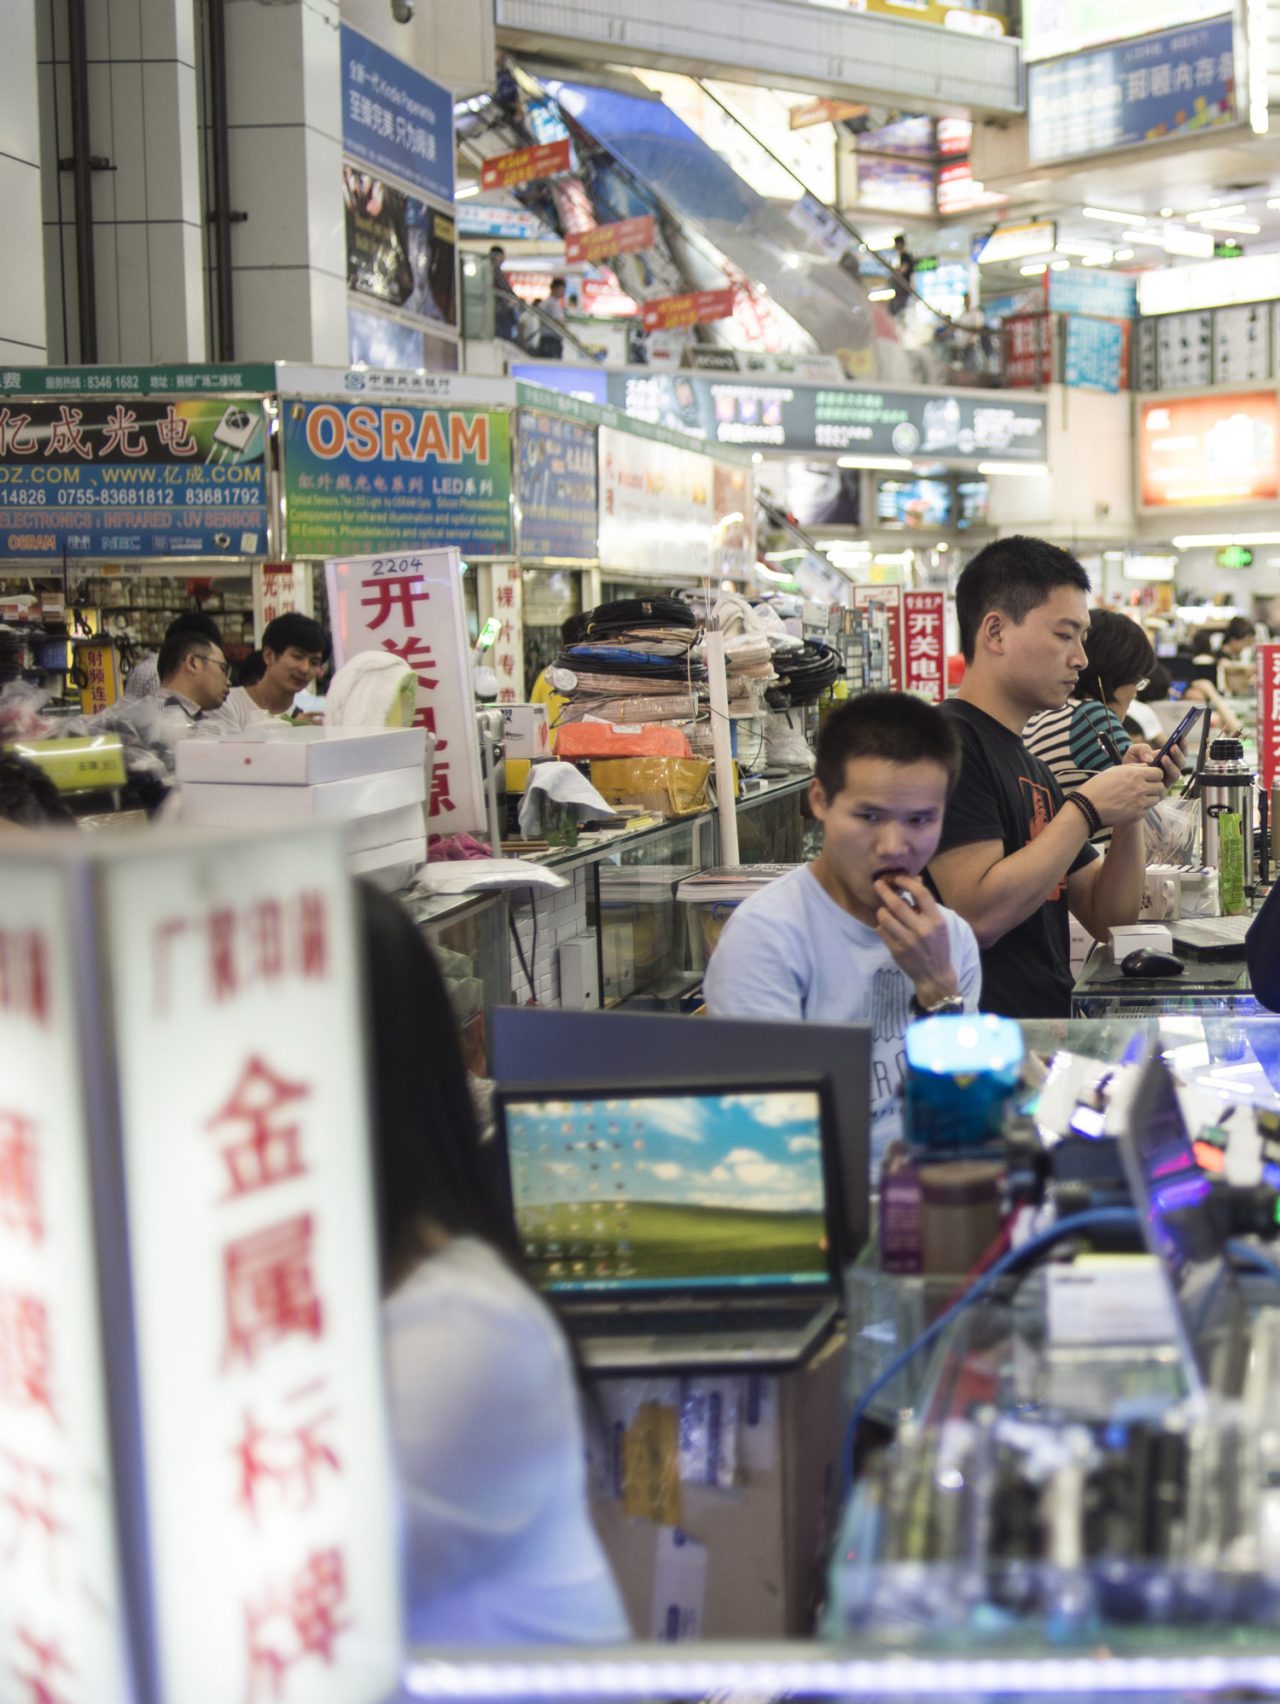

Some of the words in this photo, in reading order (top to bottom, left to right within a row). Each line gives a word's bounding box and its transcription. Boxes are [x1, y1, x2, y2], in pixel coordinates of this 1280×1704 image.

[0, 372, 21, 389] 费
[0, 404, 198, 460] 亿成光电
[306, 404, 490, 465] OSRAM
[58, 488, 174, 505] 0755-83681812
[185, 488, 260, 505] 83681792
[8, 533, 56, 550] OSRAM
[371, 558, 424, 577] 2204
